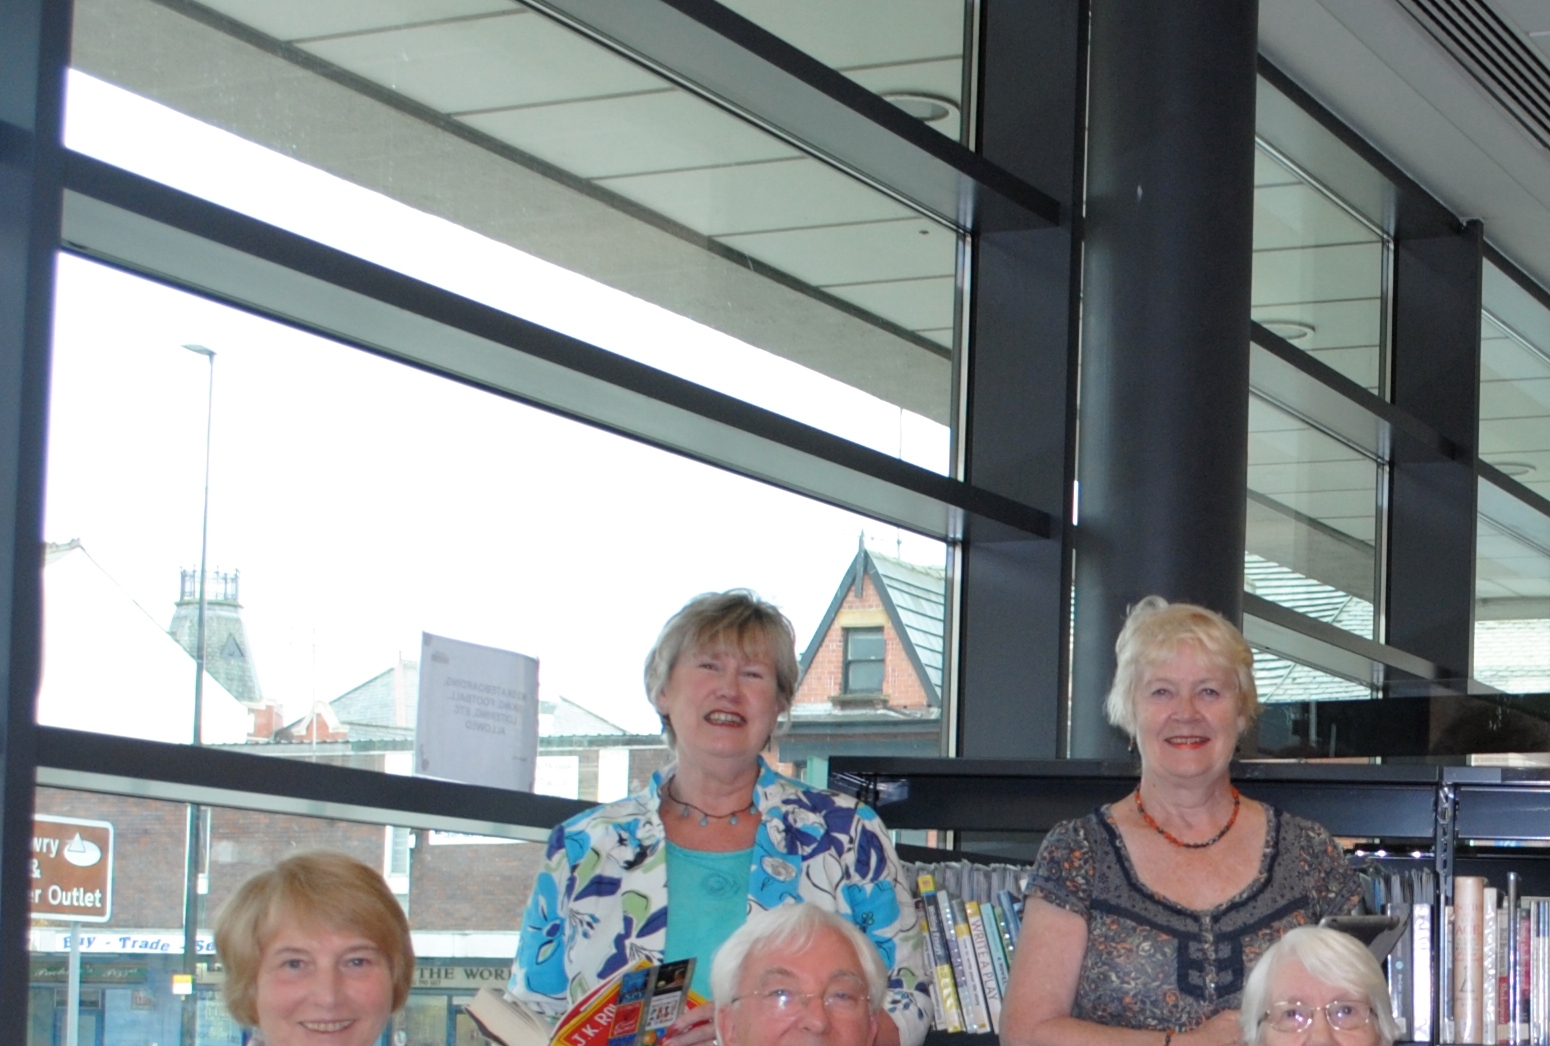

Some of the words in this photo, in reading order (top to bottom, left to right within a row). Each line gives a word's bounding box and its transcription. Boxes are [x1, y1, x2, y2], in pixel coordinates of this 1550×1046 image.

[48, 885, 102, 908] Outlet
[119, 936, 171, 952] Trade
[969, 919, 988, 959] WRITE
[982, 971, 999, 1001] PLAY
[420, 967, 455, 980] THE
[1500, 983, 1508, 1024] Shakespear
